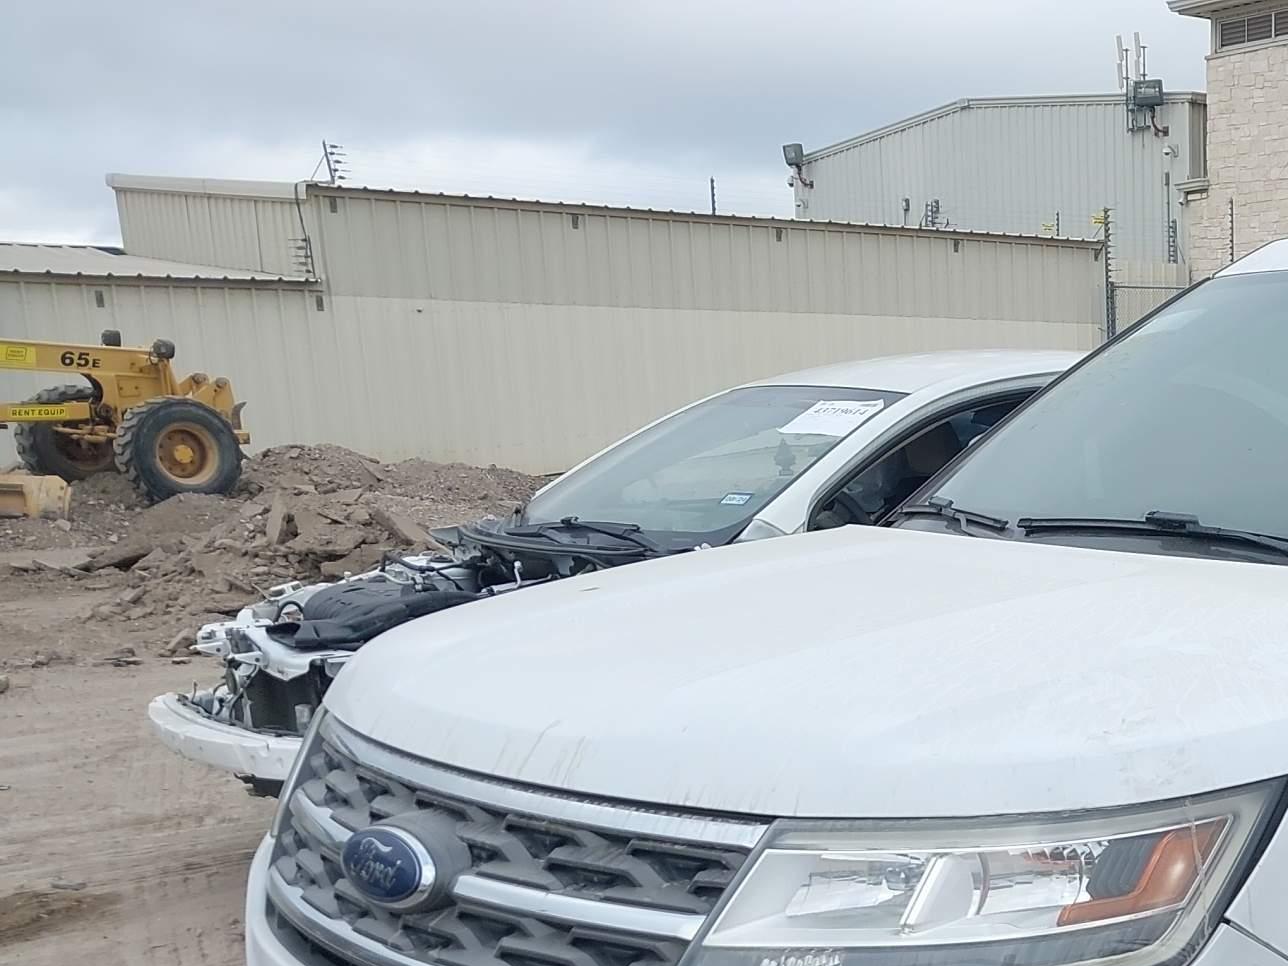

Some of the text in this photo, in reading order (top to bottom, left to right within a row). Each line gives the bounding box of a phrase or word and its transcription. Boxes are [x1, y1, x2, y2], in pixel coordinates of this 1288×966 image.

[12, 408, 65, 416] RENT EQUIP
[351, 837, 402, 889] Ford
